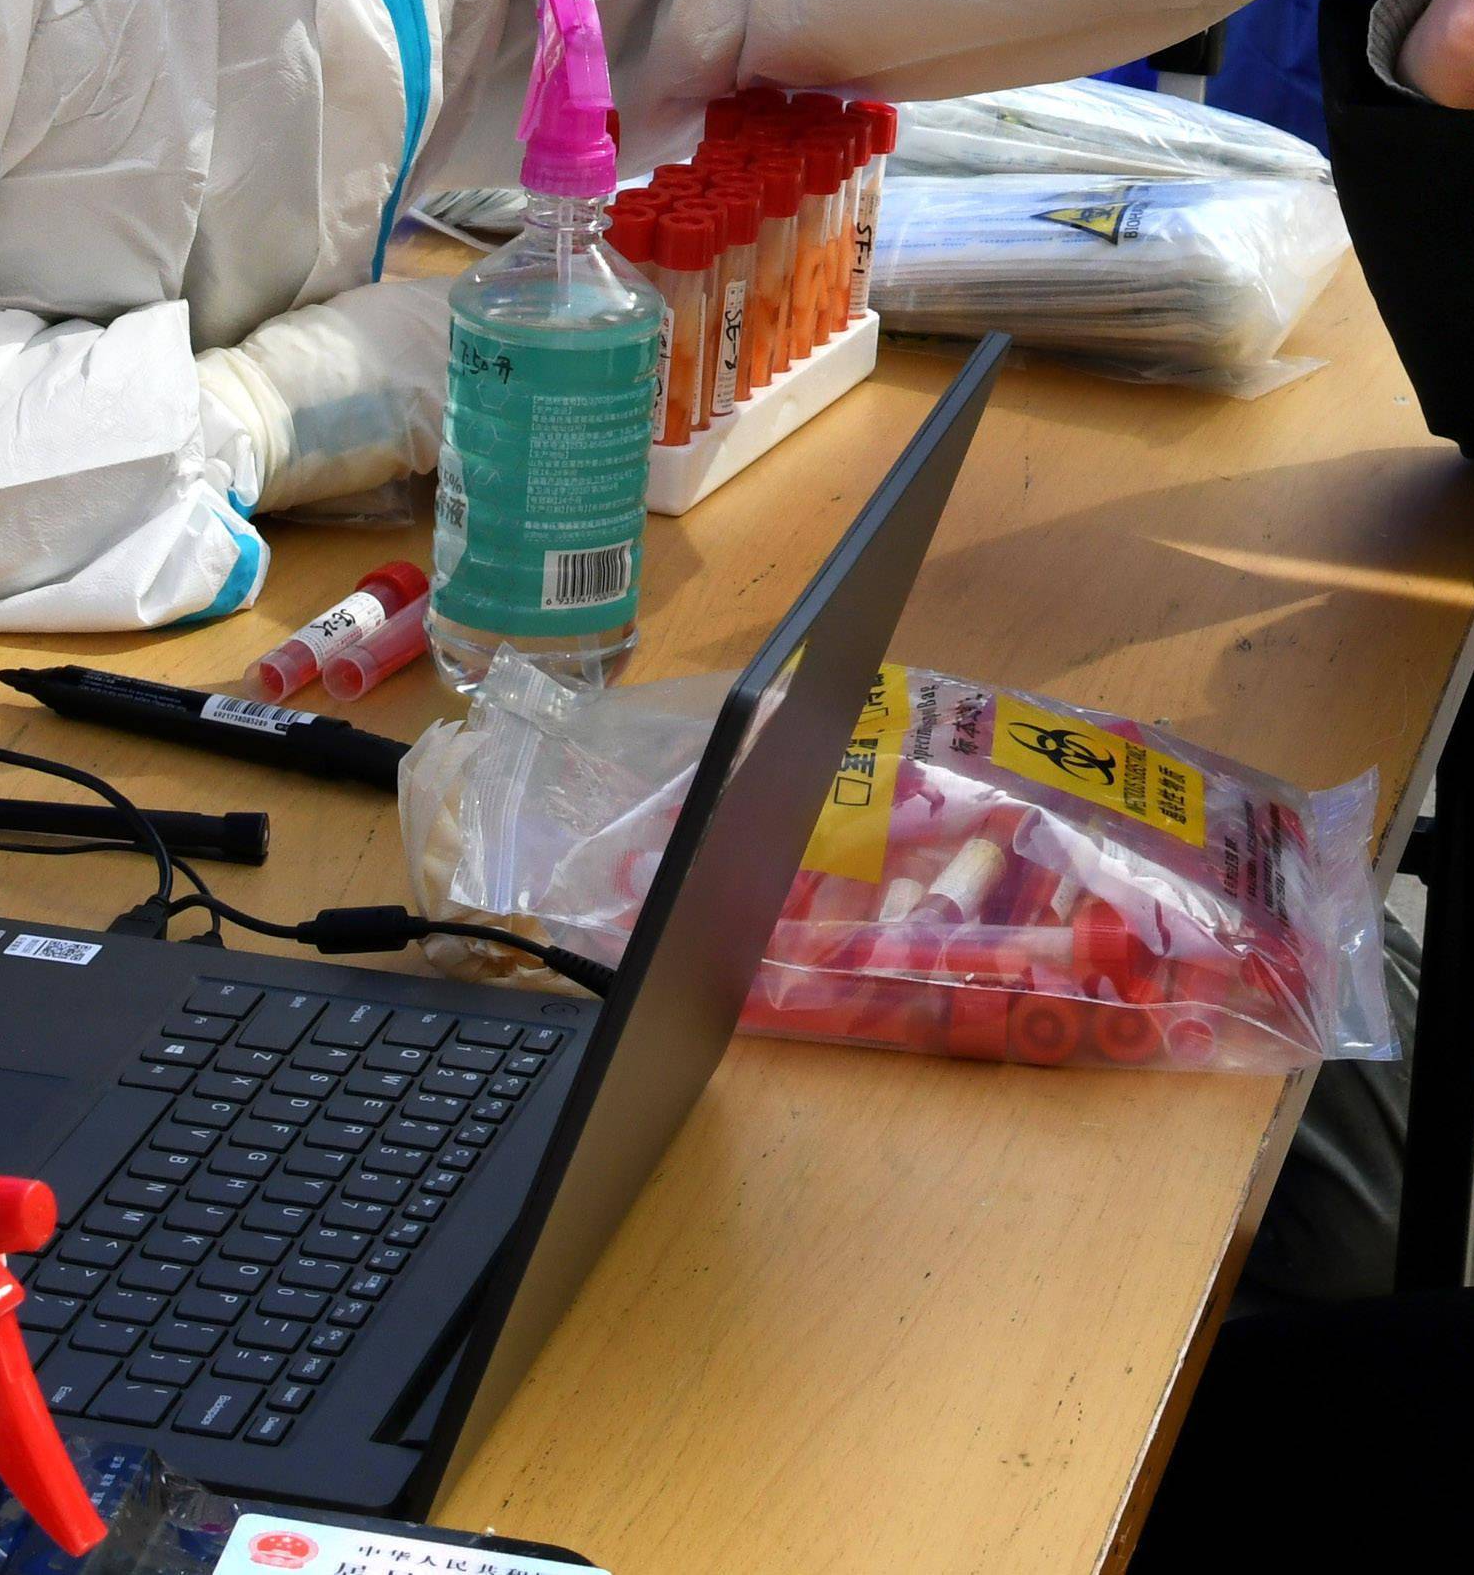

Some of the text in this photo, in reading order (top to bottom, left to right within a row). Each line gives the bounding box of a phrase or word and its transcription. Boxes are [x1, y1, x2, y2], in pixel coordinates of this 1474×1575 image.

[252, 1052, 273, 1061] Z
[328, 1049, 348, 1057] A
[400, 1049, 420, 1059] Q
[436, 1069, 455, 1077] 2
[231, 1077, 252, 1086] X
[309, 1074, 329, 1082] S
[381, 1075, 403, 1086] W
[211, 1103, 231, 1112] C
[290, 1098, 310, 1108] D
[363, 1099, 384, 1108] E
[272, 1124, 290, 1133] F
[399, 1120, 416, 1128] 4
[191, 1130, 211, 1138] V
[343, 1125, 364, 1134] R
[380, 1147, 398, 1155] 5
[168, 1155, 189, 1164] B
[247, 1152, 268, 1161] G
[325, 1154, 344, 1162] T
[360, 1173, 378, 1181] 6
[145, 1182, 167, 1193] N
[226, 1179, 248, 1189] H
[304, 1181, 324, 1189] Y
[341, 1201, 359, 1209] 7
[205, 1207, 224, 1215] J
[282, 1207, 303, 1217] U
[122, 1211, 144, 1222] M
[319, 1229, 338, 1237] 8
[182, 1235, 204, 1245] K
[298, 1259, 317, 1267] 9
[239, 1265, 260, 1275] O
[277, 1288, 295, 1296] 0
[221, 1294, 238, 1304] P
[357, 1543, 550, 1575] 中华人民共和
